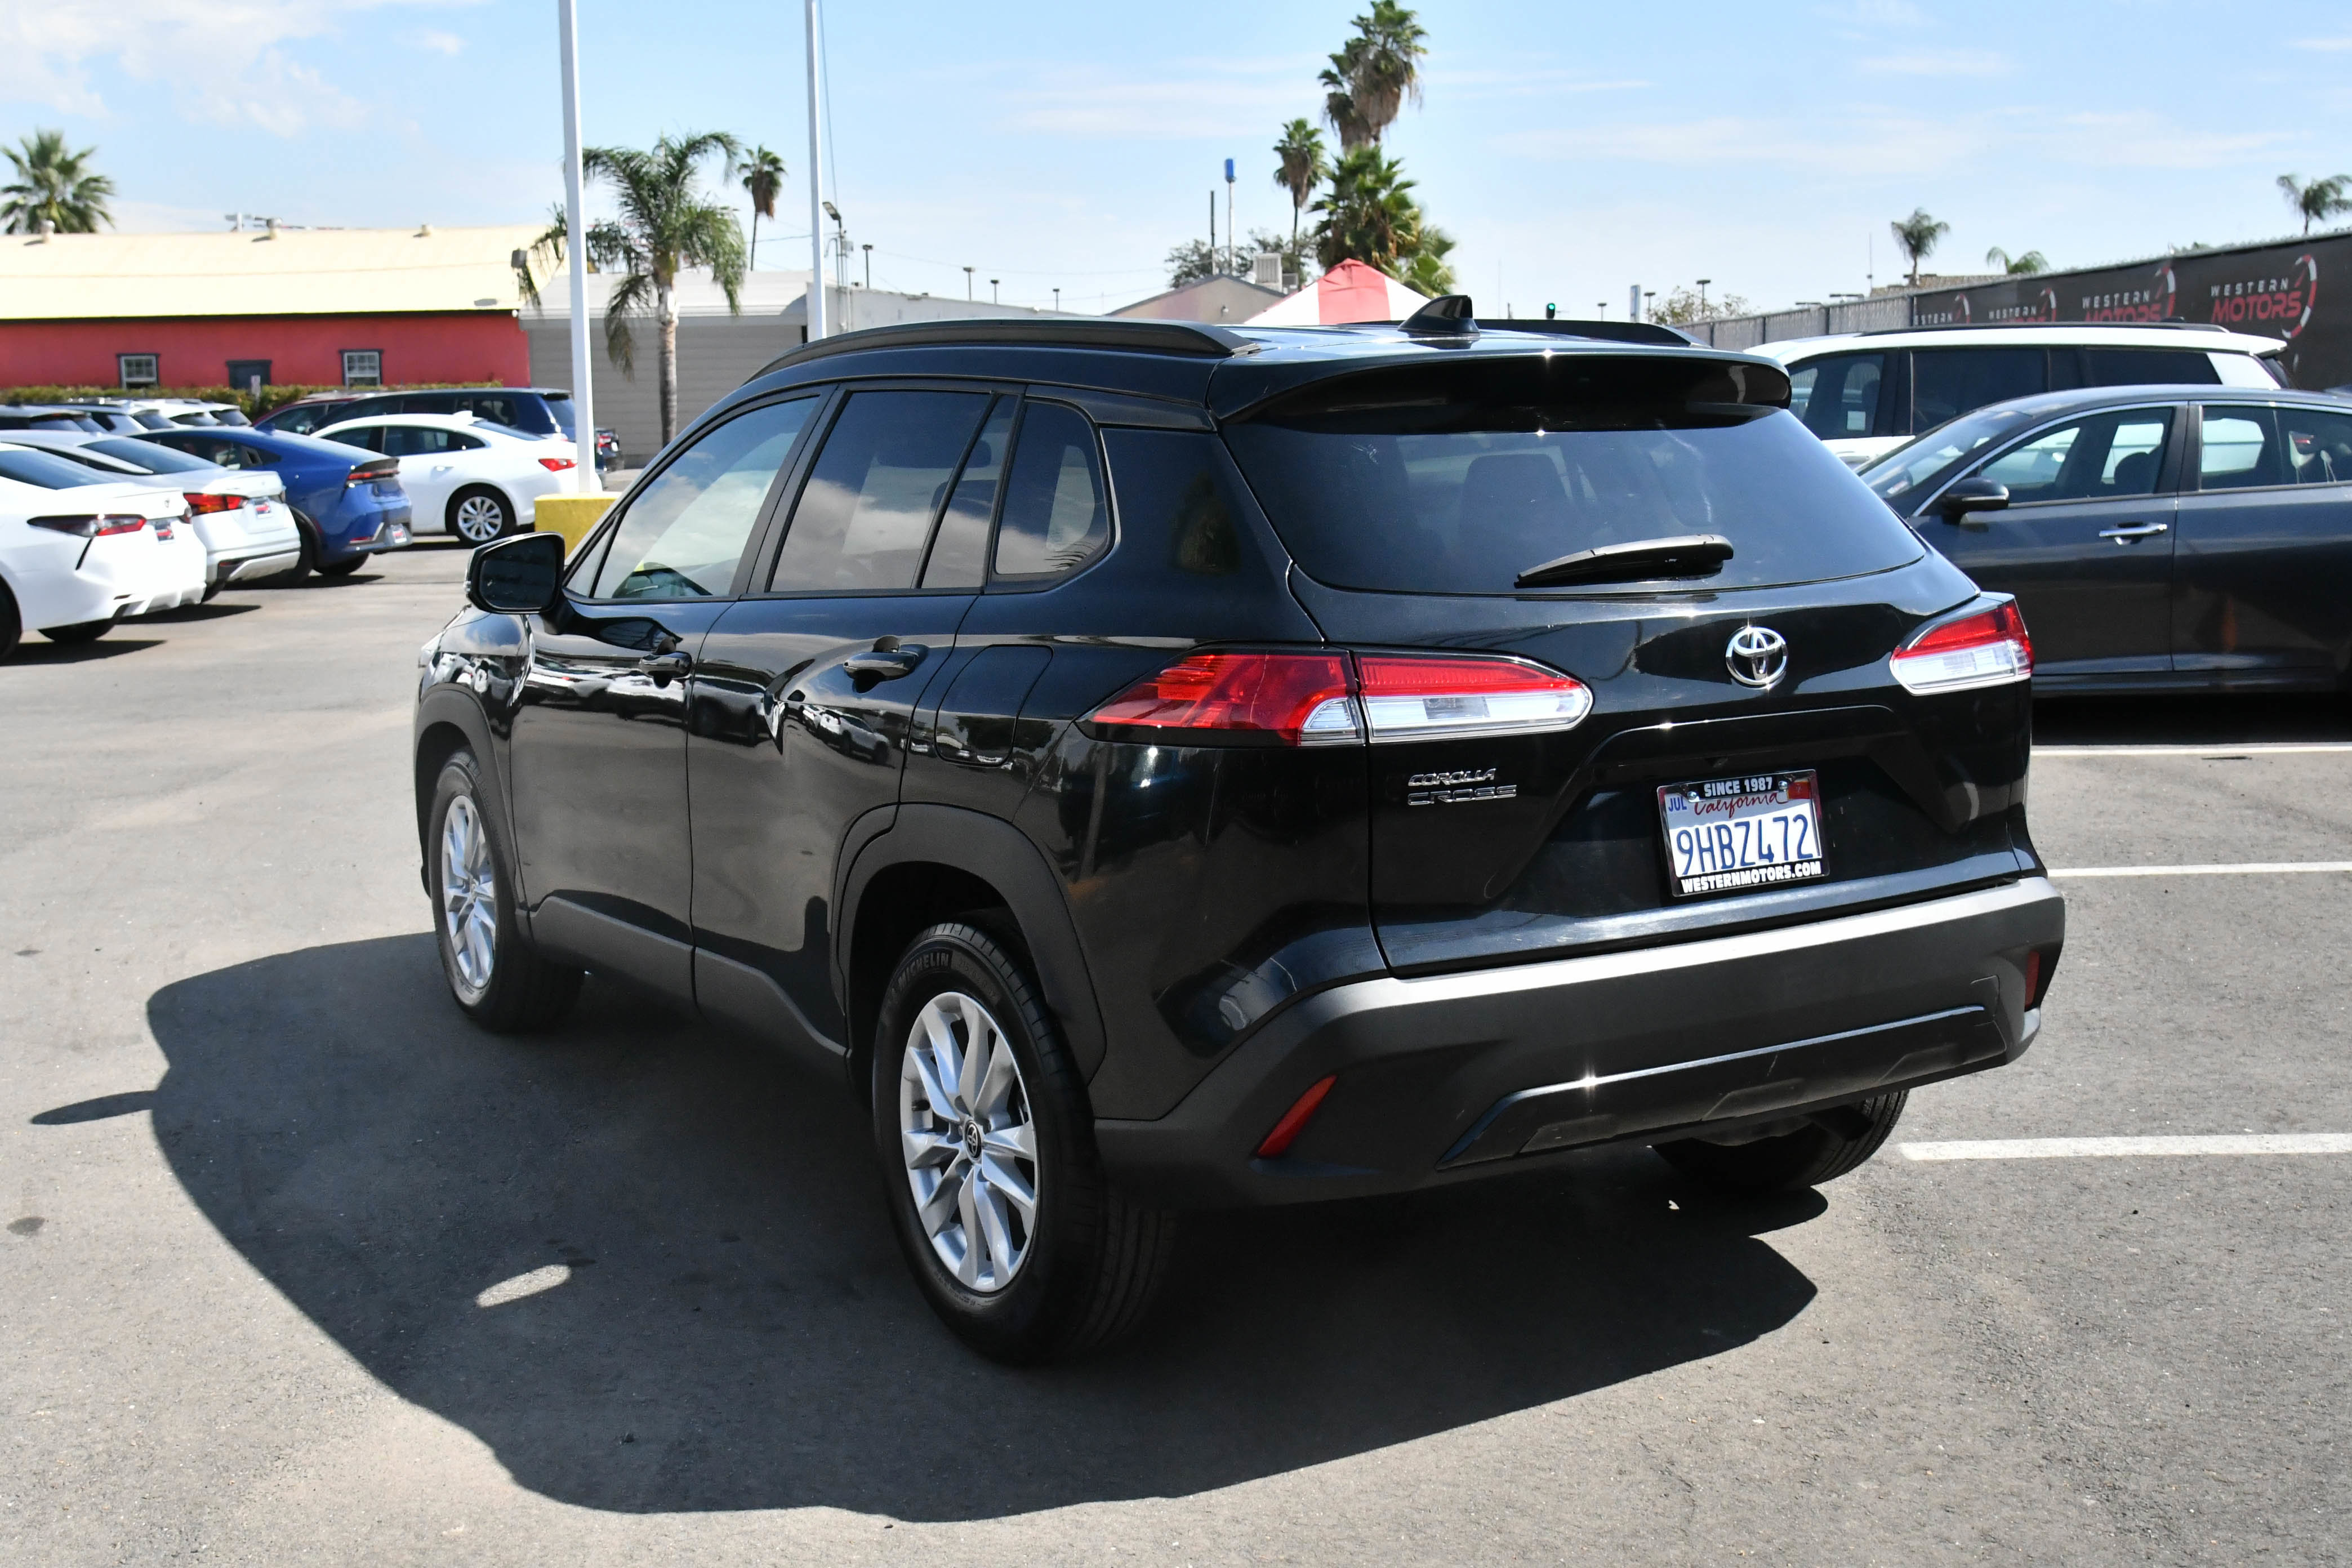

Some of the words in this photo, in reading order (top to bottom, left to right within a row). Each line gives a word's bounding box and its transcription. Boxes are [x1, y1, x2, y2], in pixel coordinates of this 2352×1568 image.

[2211, 278, 2289, 297] WESTERN
[2082, 290, 2150, 309] WESTERN
[2210, 291, 2302, 323] MOTORS
[1913, 313, 1952, 325] ESTERN
[1408, 768, 1496, 786] COROLLA
[1704, 779, 1740, 797] SINCE
[1744, 777, 1772, 792] 1987
[1407, 785, 1517, 805] CROSS
[1668, 795, 1687, 812] JUL
[1676, 814, 1814, 875] 9HBZ472
[1681, 861, 1822, 893] WESTERNMOTORS.COM
[898, 952, 950, 992] MICHELIN
